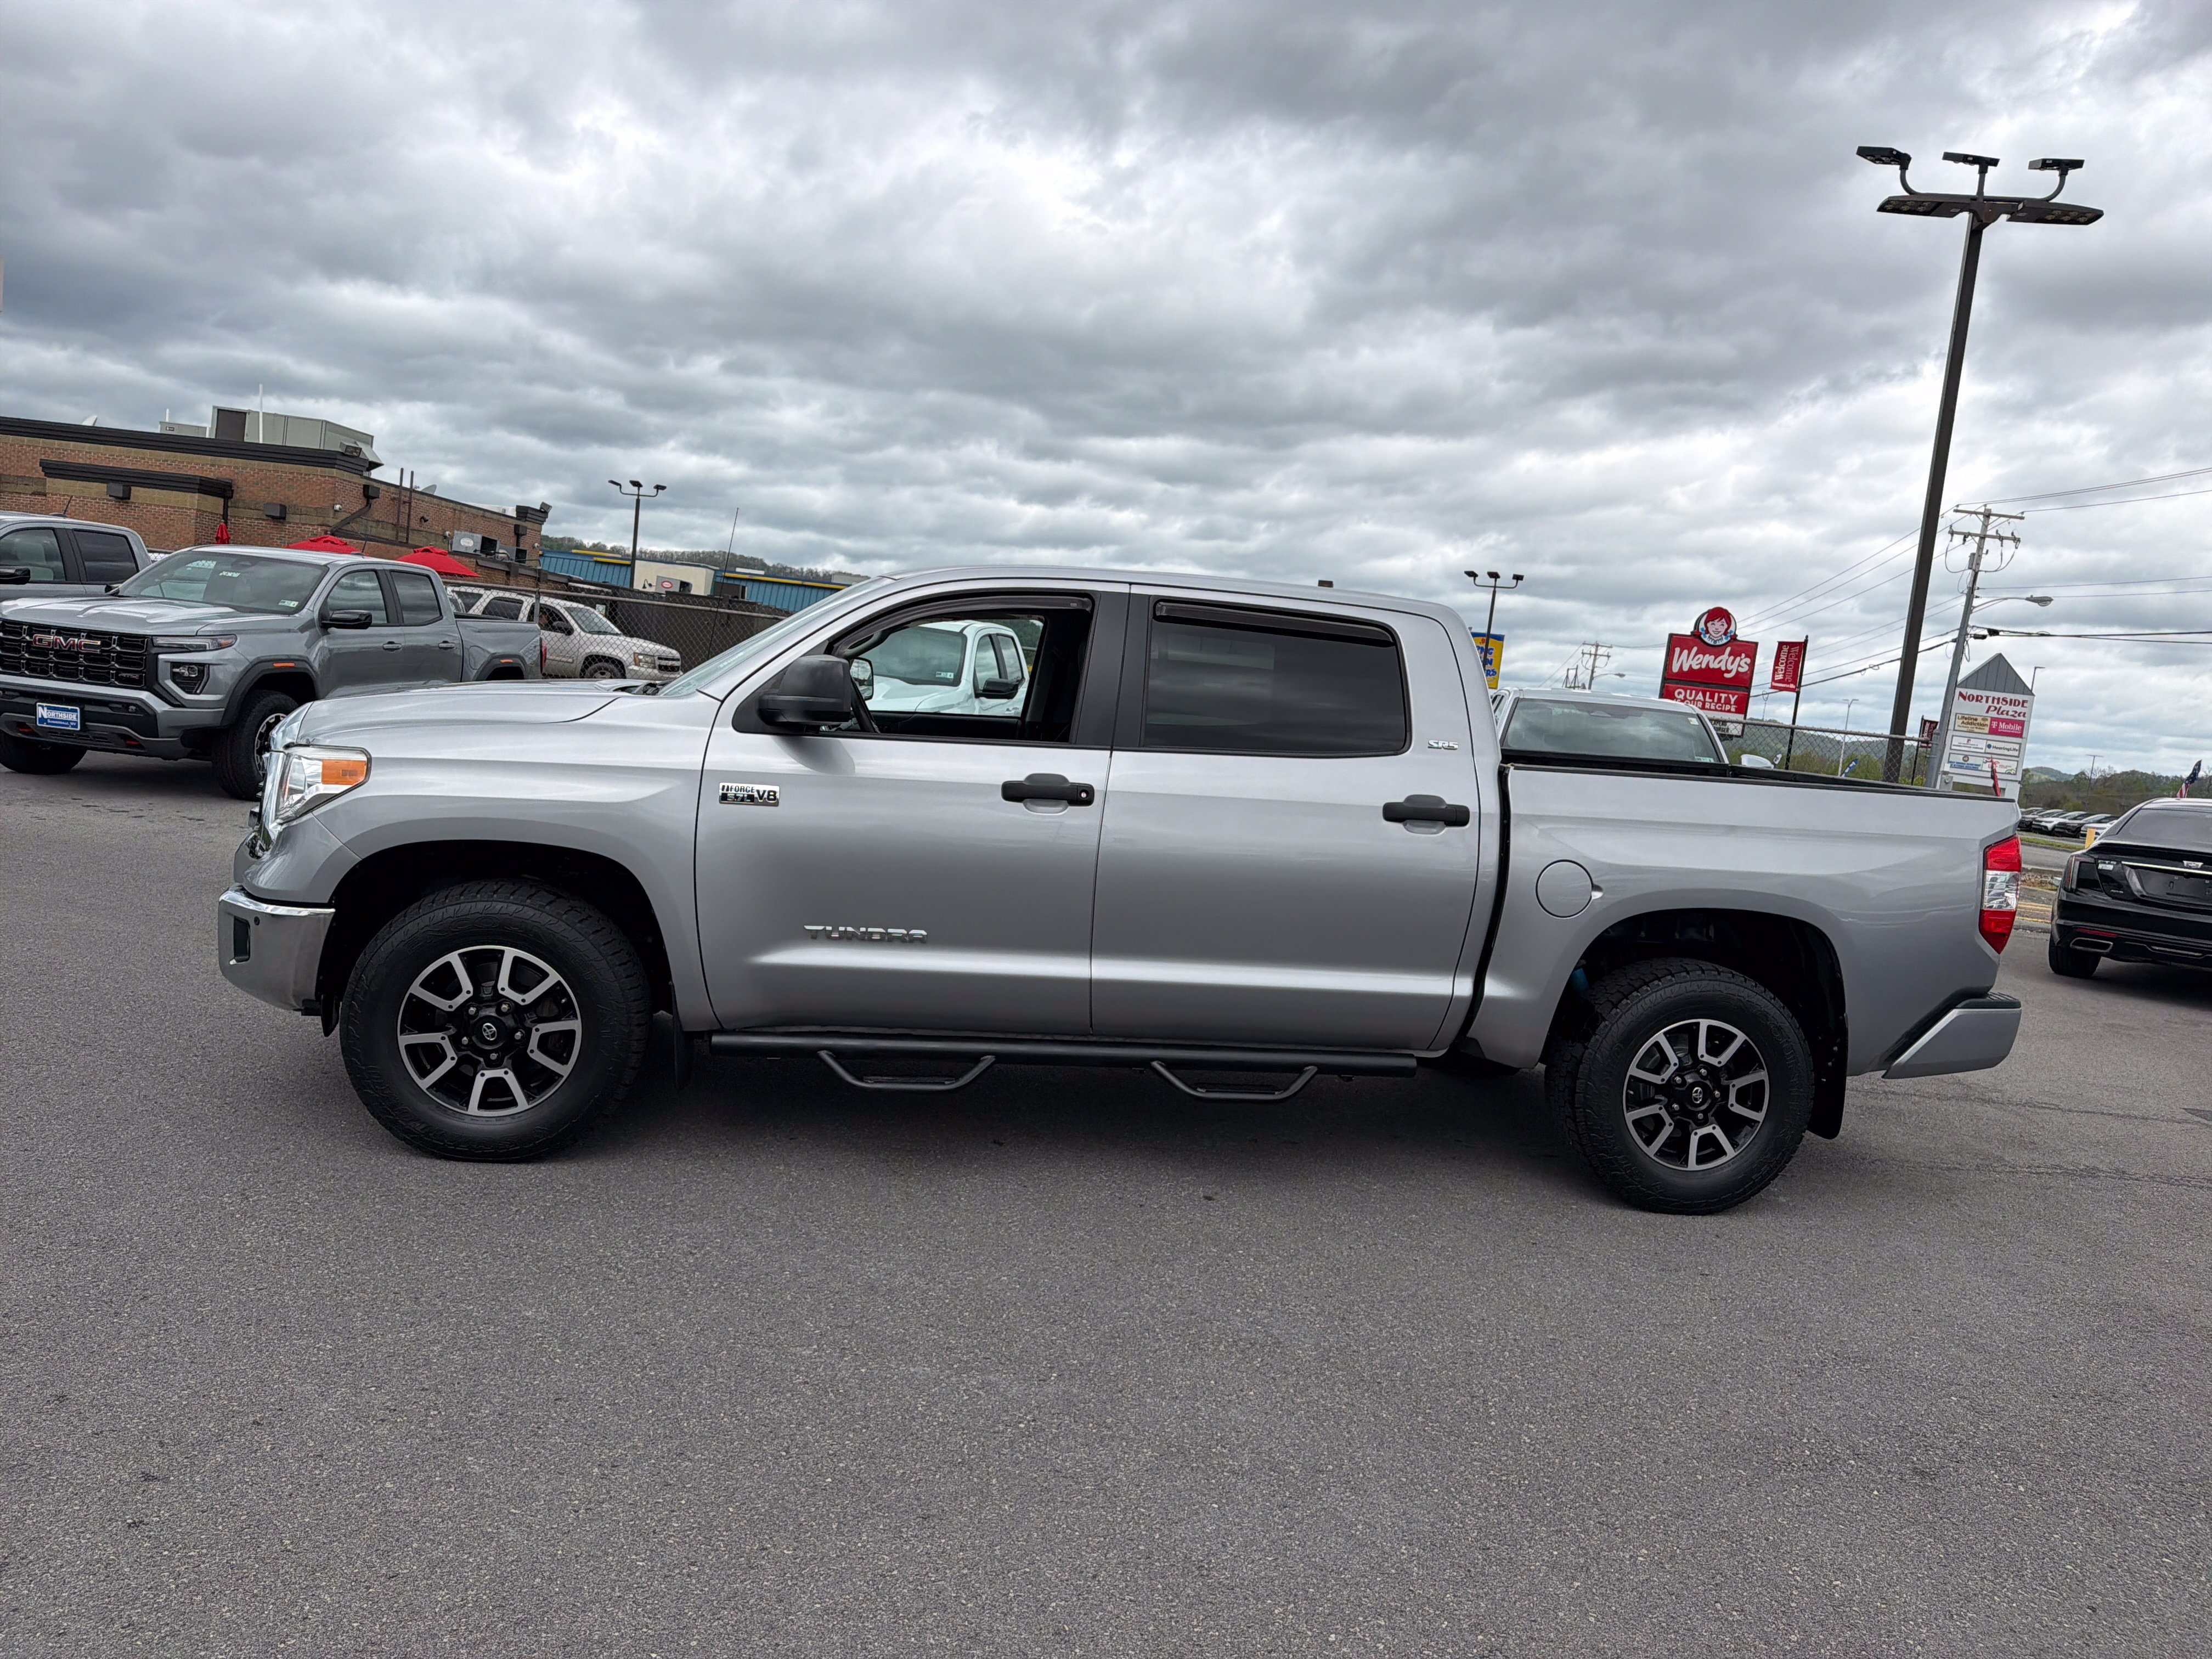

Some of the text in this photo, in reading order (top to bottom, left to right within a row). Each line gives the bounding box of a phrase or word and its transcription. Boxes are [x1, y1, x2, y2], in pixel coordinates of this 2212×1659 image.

[32, 634, 101, 654] GMC
[1672, 646, 1751, 678] Wendy's
[1775, 645, 1790, 680] Welcome
[1785, 646, 1799, 682] Welcome
[1674, 689, 1738, 705] QUALITY
[1957, 691, 2029, 708] NORTHSIDE
[38, 706, 77, 720] NORTHSIDE
[1705, 702, 1736, 712] RECIPE
[1985, 705, 2027, 718] Plaza
[1999, 721, 2022, 731] Mobile
[1427, 740, 1459, 750] SR5
[755, 789, 777, 803] V8
[804, 925, 928, 944] TUNDRA
